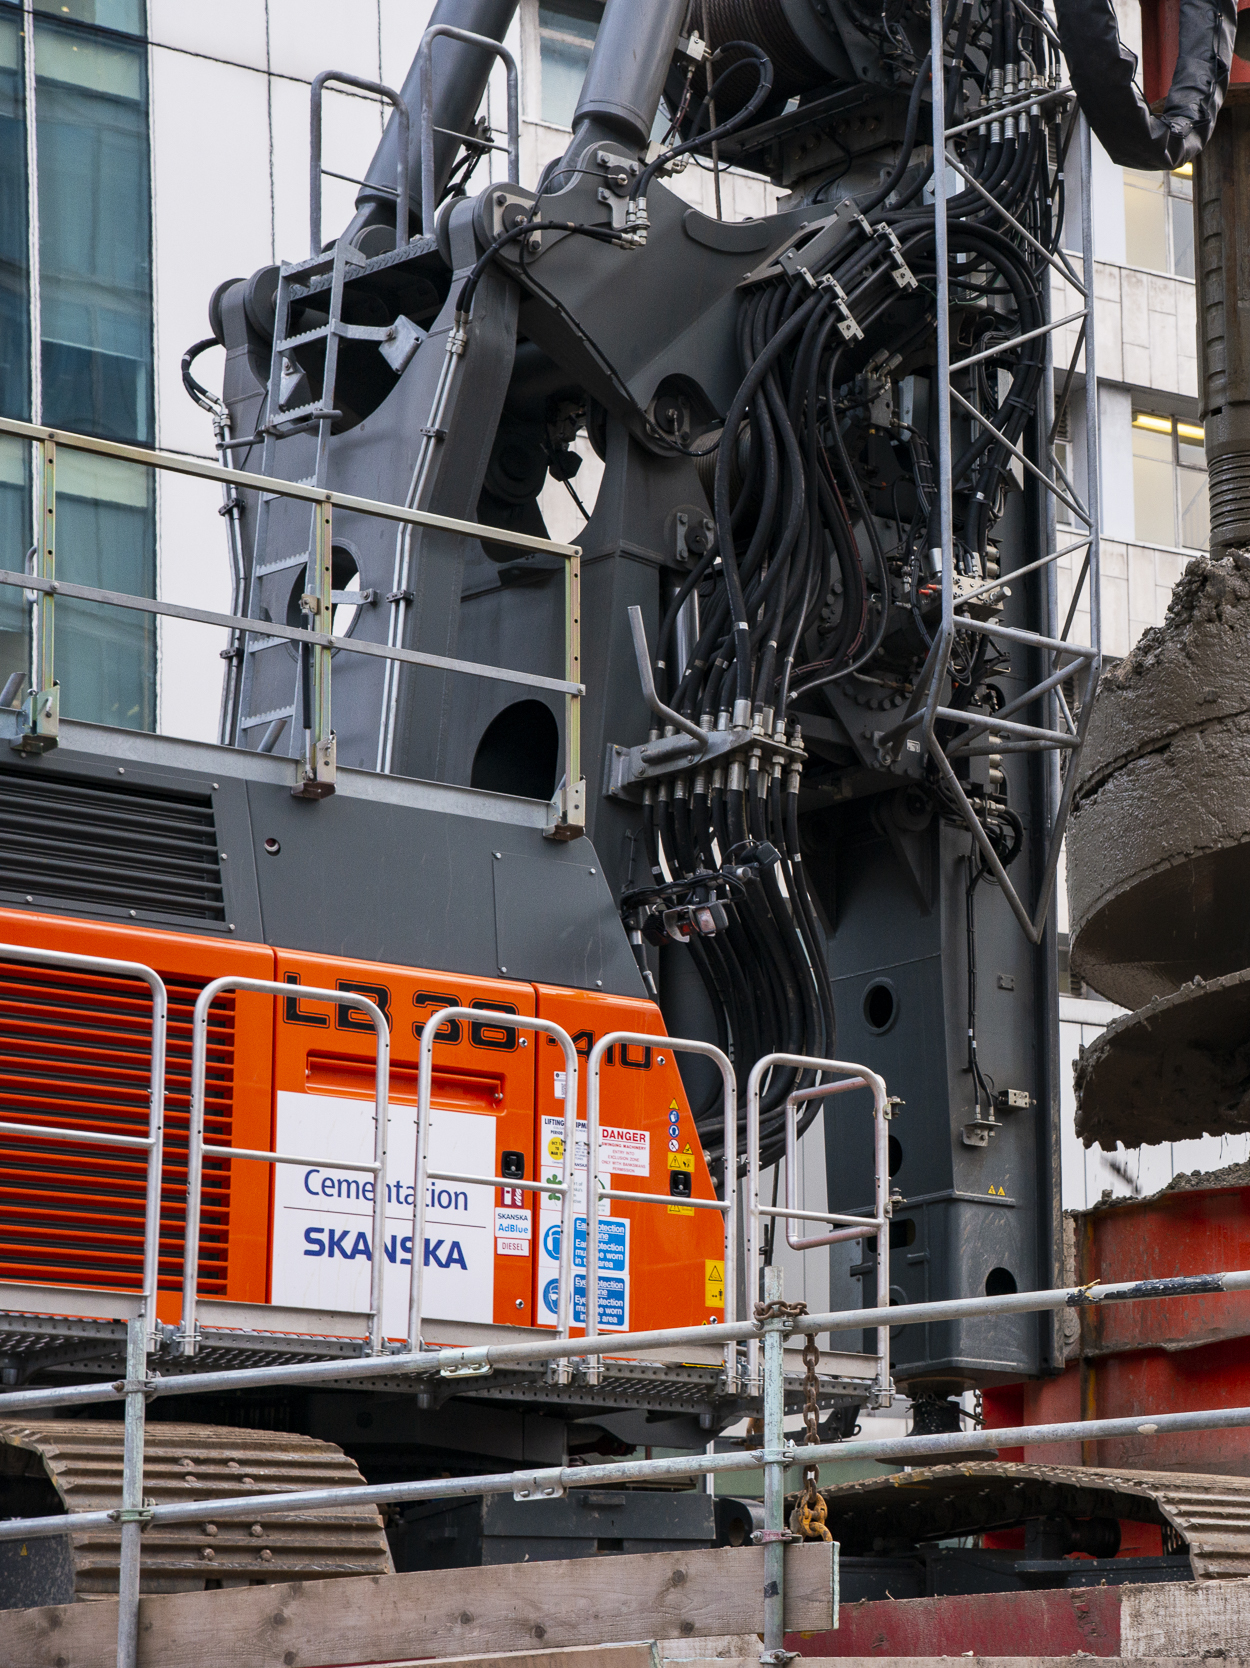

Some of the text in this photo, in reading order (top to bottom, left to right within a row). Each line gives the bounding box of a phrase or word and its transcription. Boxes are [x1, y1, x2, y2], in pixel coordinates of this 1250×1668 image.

[283, 971, 393, 1035] LB
[412, 989, 519, 1053] 38
[545, 1119, 565, 1127] LIFTING
[603, 1129, 646, 1143] DANGER
[497, 1212, 529, 1221] SKANSKA
[498, 1223, 529, 1234] AdBlue
[598, 1224, 625, 1233] otection
[303, 1226, 469, 1271] SKANSKA
[501, 1241, 524, 1252] DIESEL
[598, 1242, 624, 1252] otection
[605, 1252, 624, 1260] worn
[575, 1256, 582, 1264] in
[598, 1260, 614, 1268] area
[598, 1280, 624, 1289] otection
[597, 1298, 624, 1307] otection
[605, 1307, 623, 1315] worn
[602, 1315, 618, 1323] area
